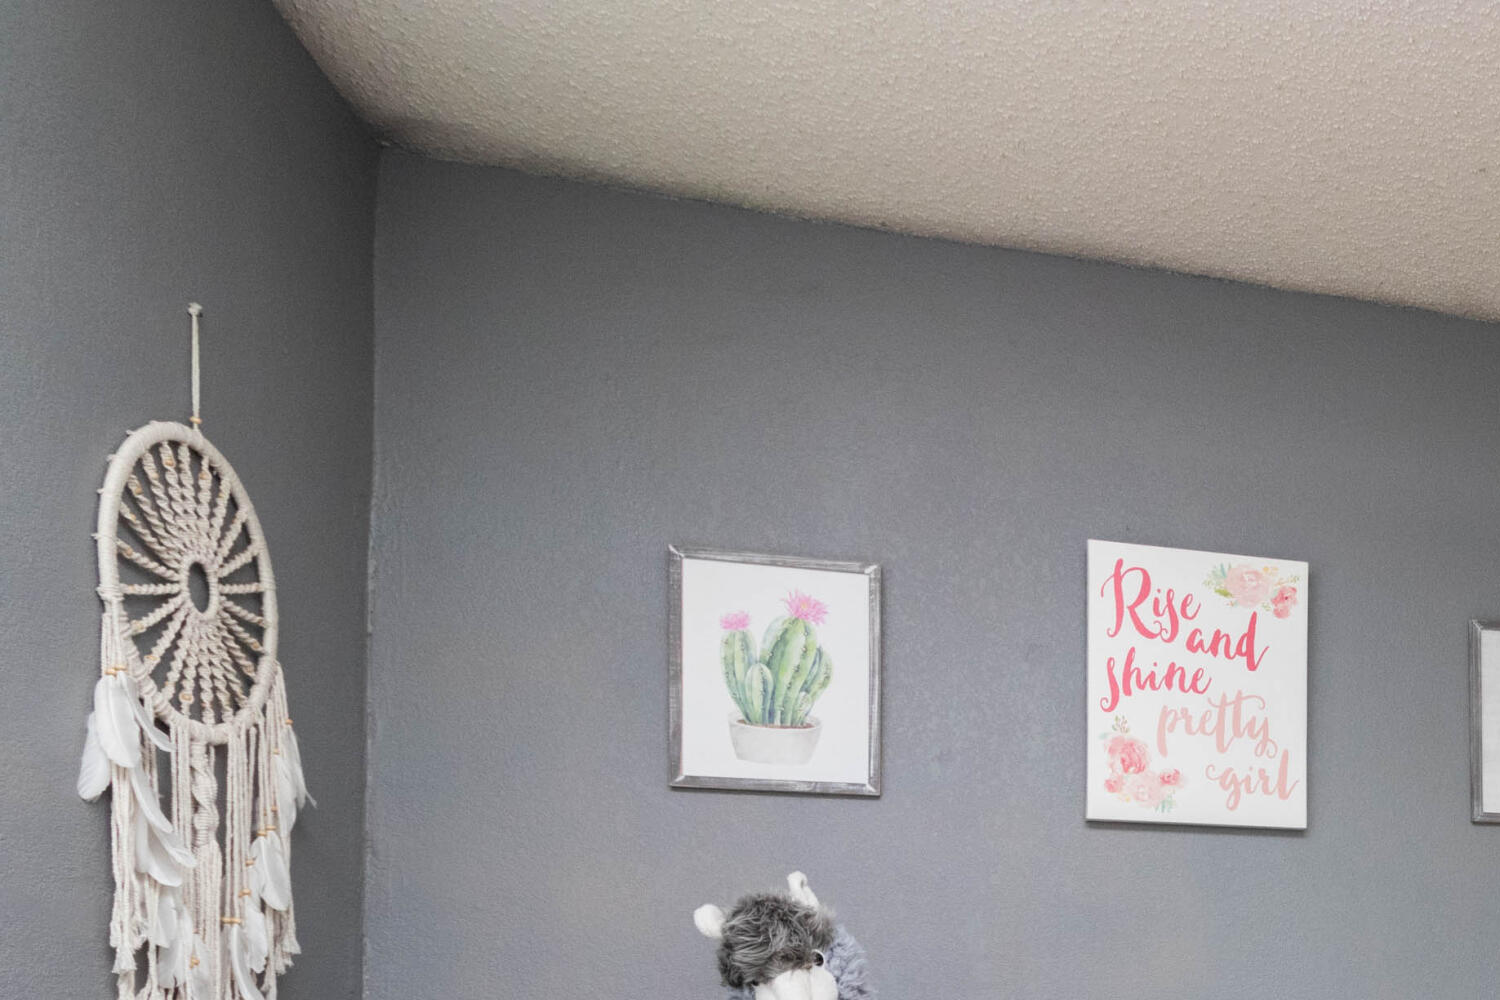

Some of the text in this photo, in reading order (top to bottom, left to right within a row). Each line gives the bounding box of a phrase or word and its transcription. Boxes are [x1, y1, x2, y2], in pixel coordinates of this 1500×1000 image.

[1101, 558, 1269, 671] Rise and
[1156, 689, 1278, 758] pretty
[1205, 749, 1299, 811] girl
